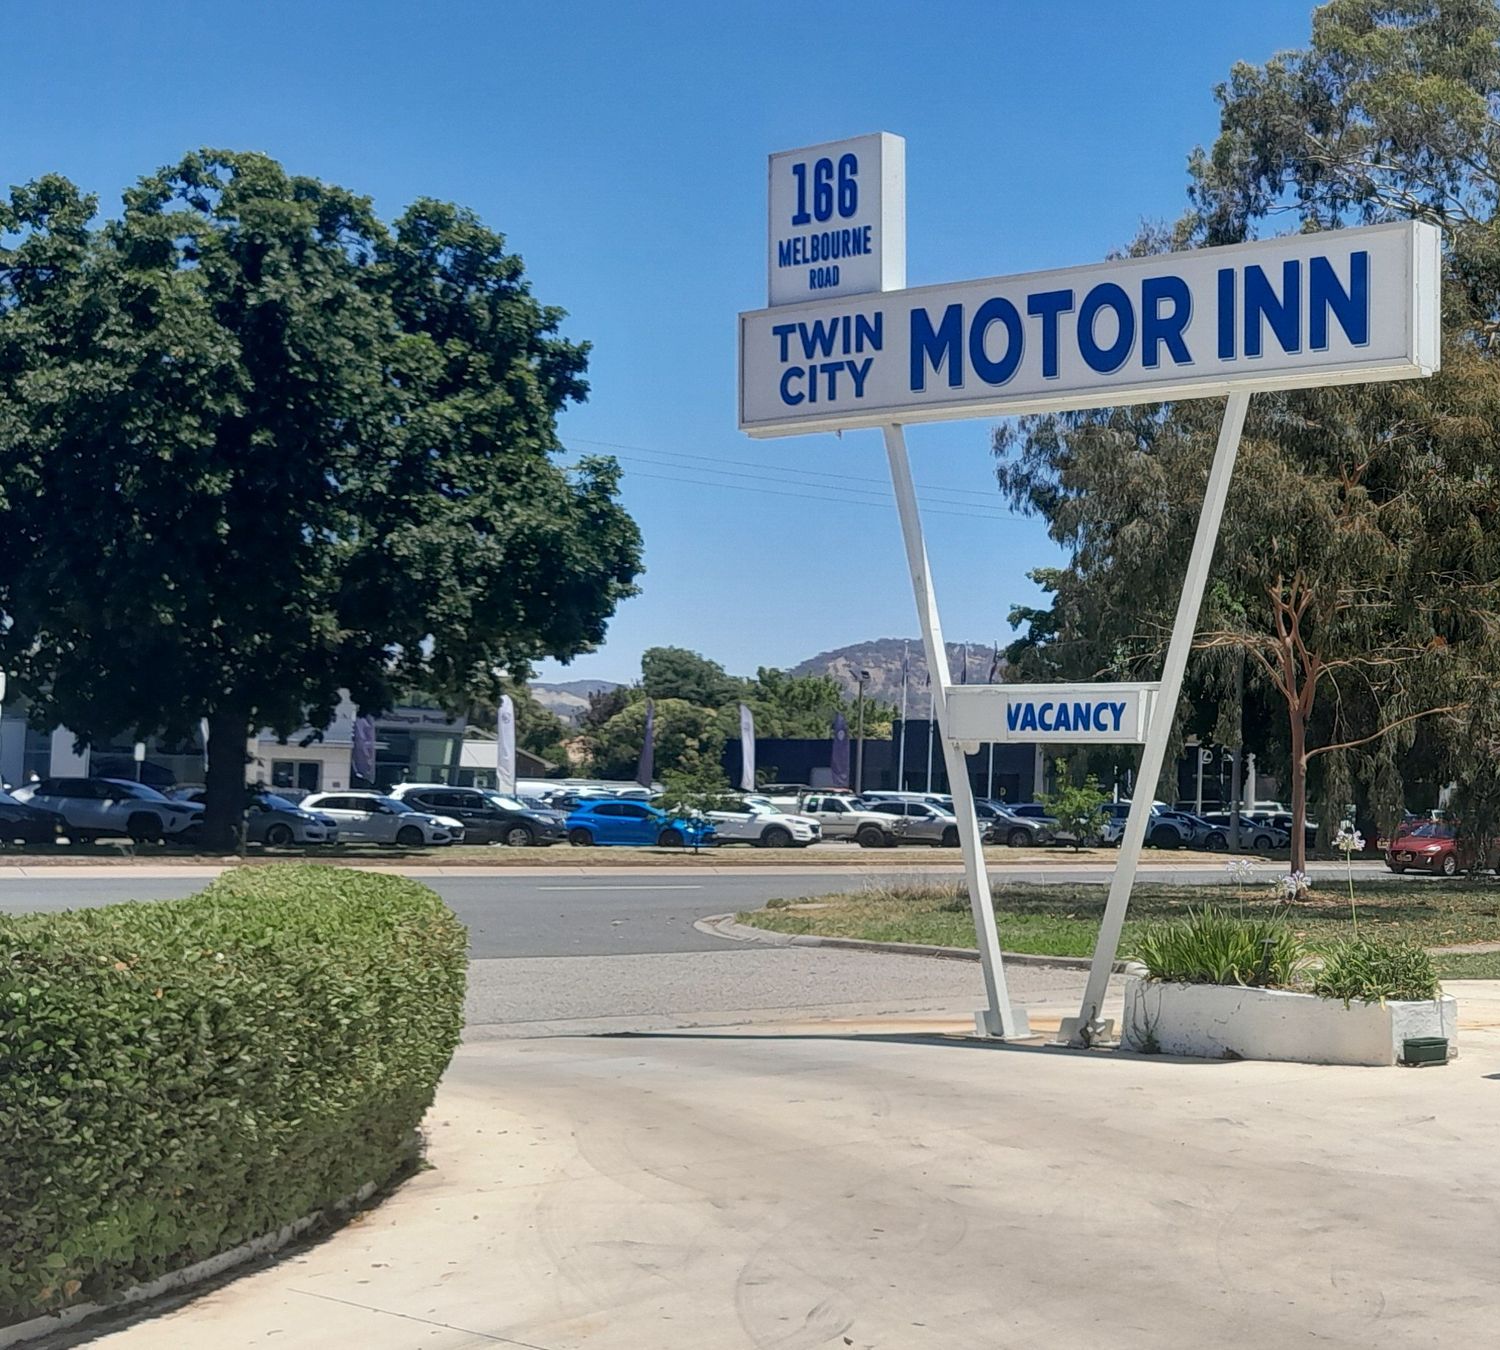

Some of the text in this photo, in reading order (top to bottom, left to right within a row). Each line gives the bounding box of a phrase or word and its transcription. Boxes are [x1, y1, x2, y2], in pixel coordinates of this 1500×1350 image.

[792, 153, 858, 225] 166
[778, 226, 872, 268] MELBOURNE
[809, 265, 840, 290] ROAD
[772, 312, 882, 362] TWIN
[910, 251, 1371, 391] MOTOR INN
[780, 358, 874, 405] CITY
[1007, 702, 1126, 731] VACANCY
